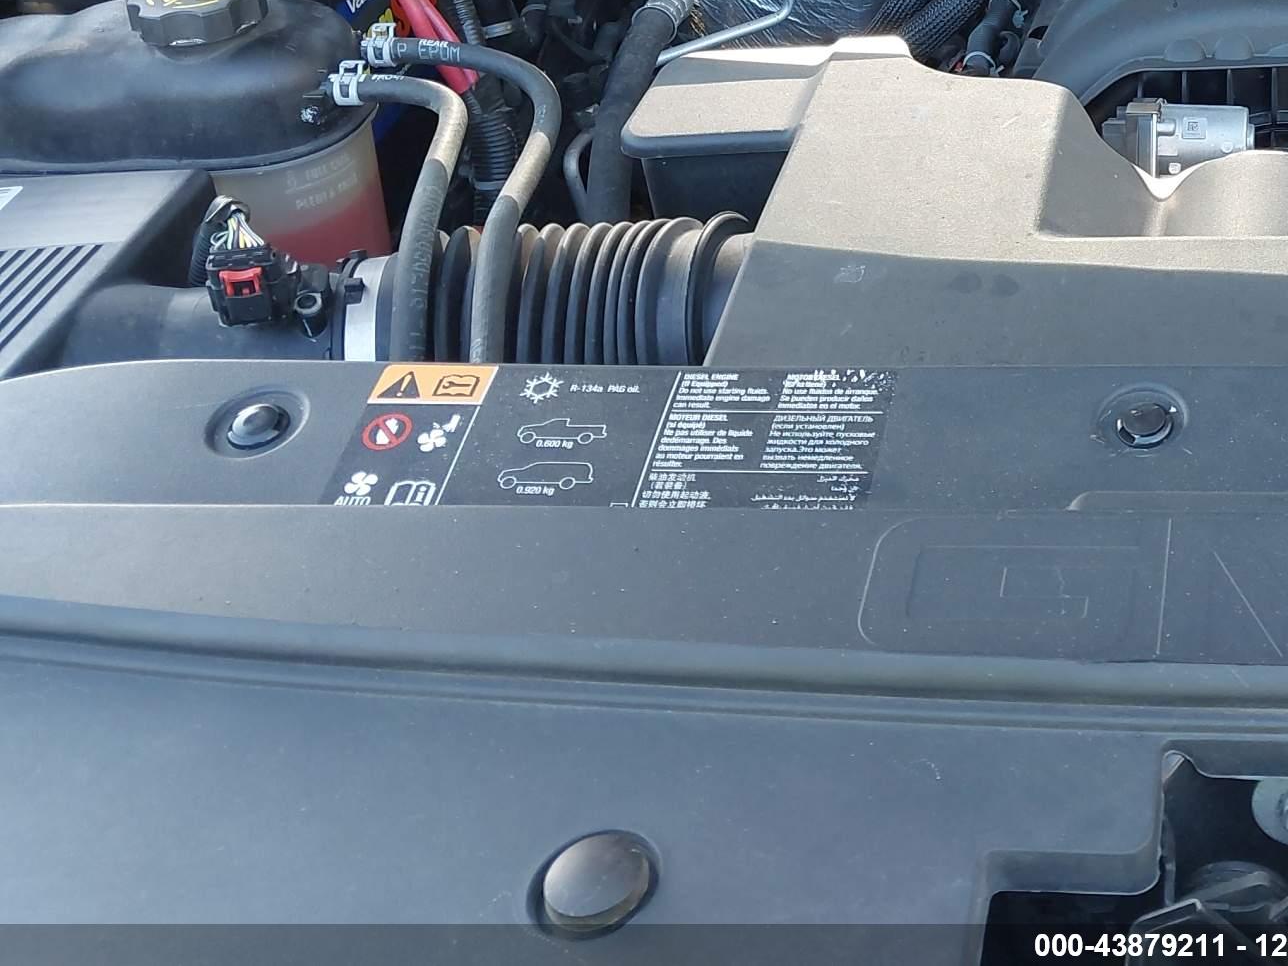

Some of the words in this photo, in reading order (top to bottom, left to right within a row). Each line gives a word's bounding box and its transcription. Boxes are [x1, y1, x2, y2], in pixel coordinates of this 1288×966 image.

[684, 373, 710, 381] DIESEL
[711, 373, 739, 381] ENGINE
[569, 384, 604, 393] R-134a
[607, 384, 626, 393] PAG
[691, 380, 728, 389] Equipped)
[718, 387, 746, 396] starting
[747, 387, 769, 395] fluids.
[845, 388, 879, 396] arranque.
[676, 394, 714, 402] Immediate
[715, 395, 740, 403] engine
[741, 395, 771, 403] damage
[790, 395, 818, 403] pueden
[819, 395, 850, 403] producir
[777, 402, 818, 410] inmediatos
[838, 402, 861, 410] motor.
[701, 414, 729, 422] DIESEL
[773, 414, 826, 422] ДИЗЕЛЬНЫЙ
[826, 415, 874, 423] ДВИГАТЕЛЬ
[666, 421, 677, 429] (si
[771, 423, 794, 431] (если
[795, 423, 845, 431] установлен)
[728, 429, 754, 437] liquide
[535, 439, 561, 448] 0.600
[561, 439, 574, 449] kg
[658, 445, 699, 453] dommages
[694, 453, 734, 461] pourraient
[516, 486, 542, 494] 0.920
[542, 486, 555, 496] kg
[334, 495, 371, 506] AUTO
